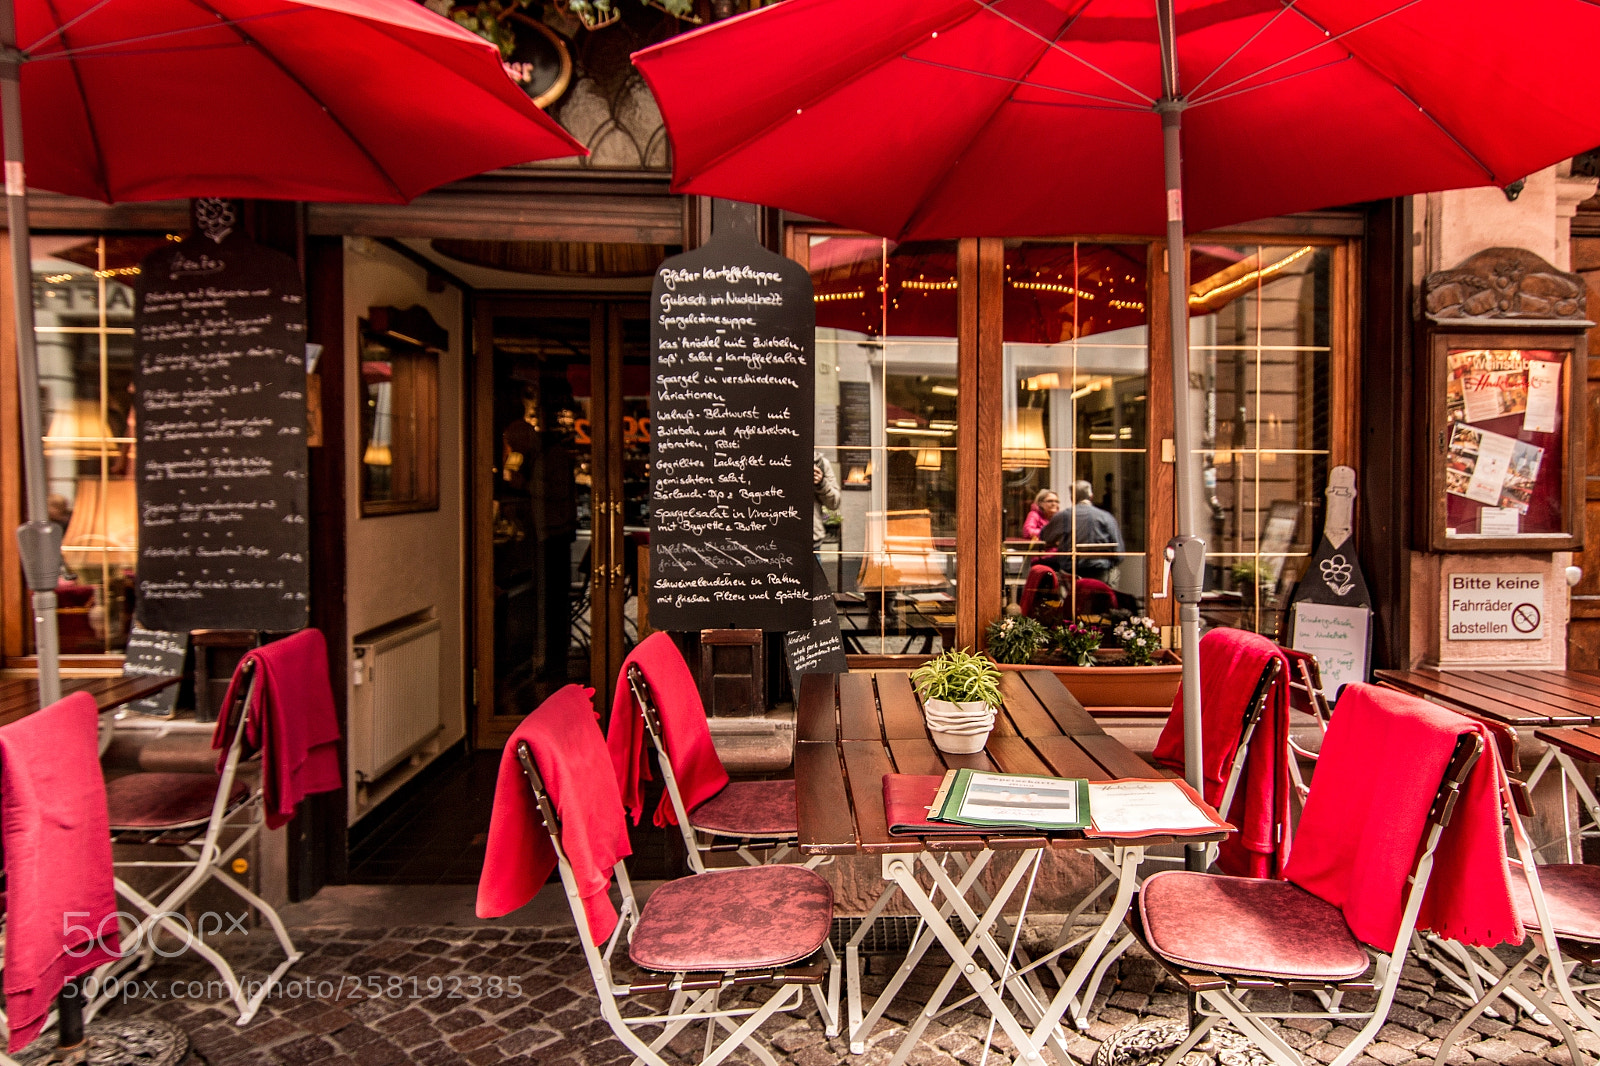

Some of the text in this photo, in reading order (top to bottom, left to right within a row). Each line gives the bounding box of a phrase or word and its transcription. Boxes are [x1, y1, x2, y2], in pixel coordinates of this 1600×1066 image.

[660, 293, 707, 313] Gulasch
[723, 336, 747, 348] mit
[687, 351, 713, 363] Salat
[725, 352, 807, 370] Kartoffelsalat
[656, 370, 799, 391] Spargel in verschiedenen
[657, 389, 726, 402] Variationen
[767, 407, 791, 419] mit
[657, 425, 701, 437] Zwiebeln
[703, 426, 727, 436] und
[713, 454, 766, 471] Lachsfilet
[769, 454, 792, 467] mit
[655, 474, 714, 491] gemischtem
[738, 484, 786, 505] Baguette
[654, 505, 802, 526] Spargelsalat in Vinaigrette
[657, 521, 677, 531] mit
[680, 520, 725, 536] Baguette
[733, 521, 767, 531] Butter
[755, 540, 778, 551] mit
[750, 577, 762, 586] in
[767, 572, 801, 585] Rahm
[1453, 577, 1540, 590] Bitte keine
[657, 594, 673, 603] mit
[713, 590, 746, 601] Pilzen
[748, 590, 770, 600] und
[1452, 599, 1512, 612] Fahrräder
[1452, 622, 1508, 635] abstellen
